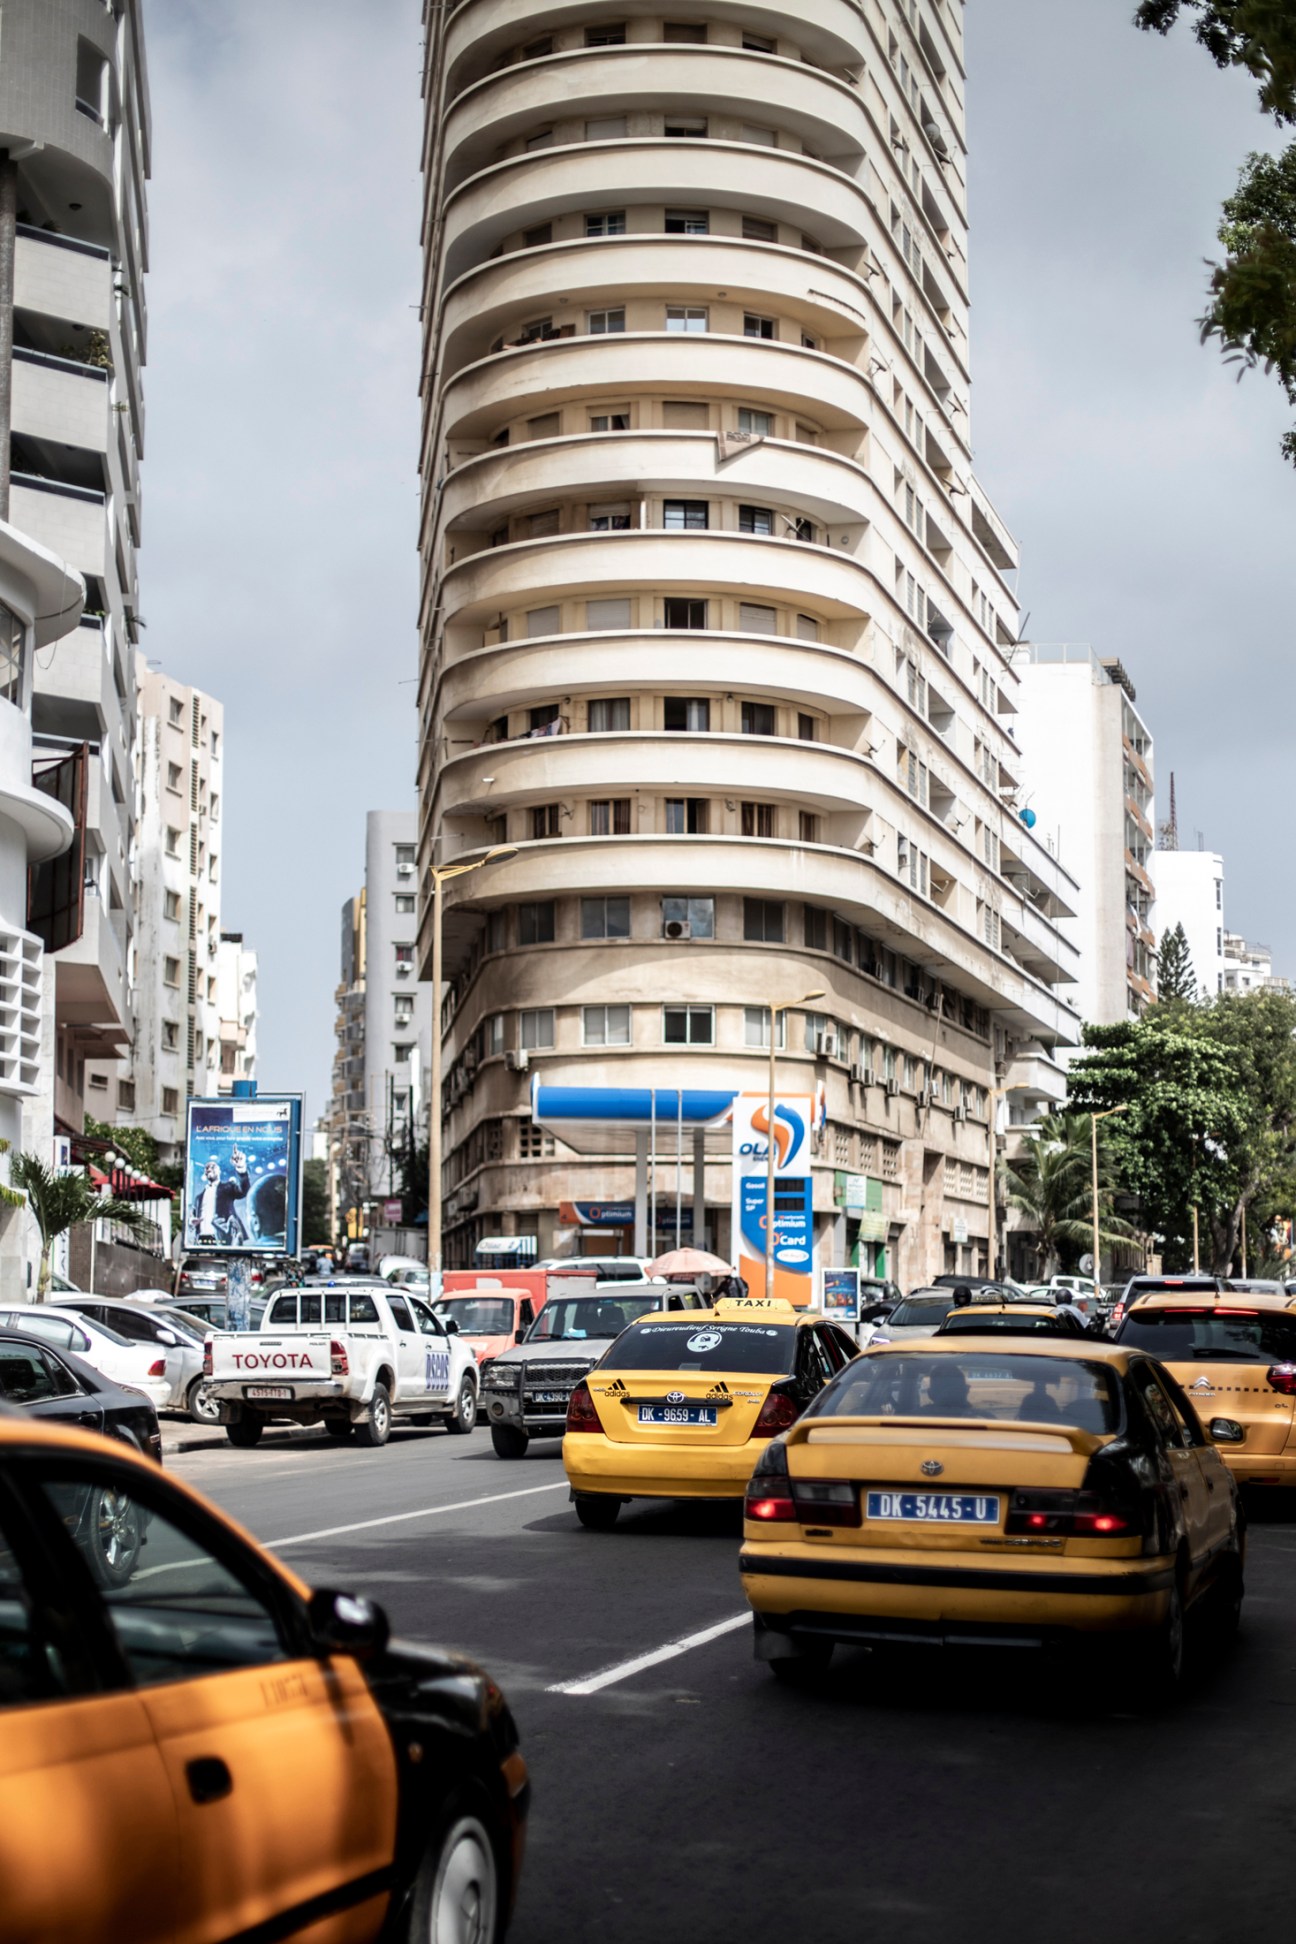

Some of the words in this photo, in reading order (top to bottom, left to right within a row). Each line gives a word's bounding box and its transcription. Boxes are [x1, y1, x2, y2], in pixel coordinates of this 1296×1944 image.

[242, 1125, 254, 1133] EN
[255, 1125, 283, 1133] NOUS
[739, 1143, 776, 1155] OLA
[735, 1299, 772, 1307] TAXI
[739, 1326, 766, 1334] Touba
[232, 1353, 314, 1369] TOYOTA
[604, 1389, 630, 1398] adidas
[705, 1391, 733, 1401] adidas
